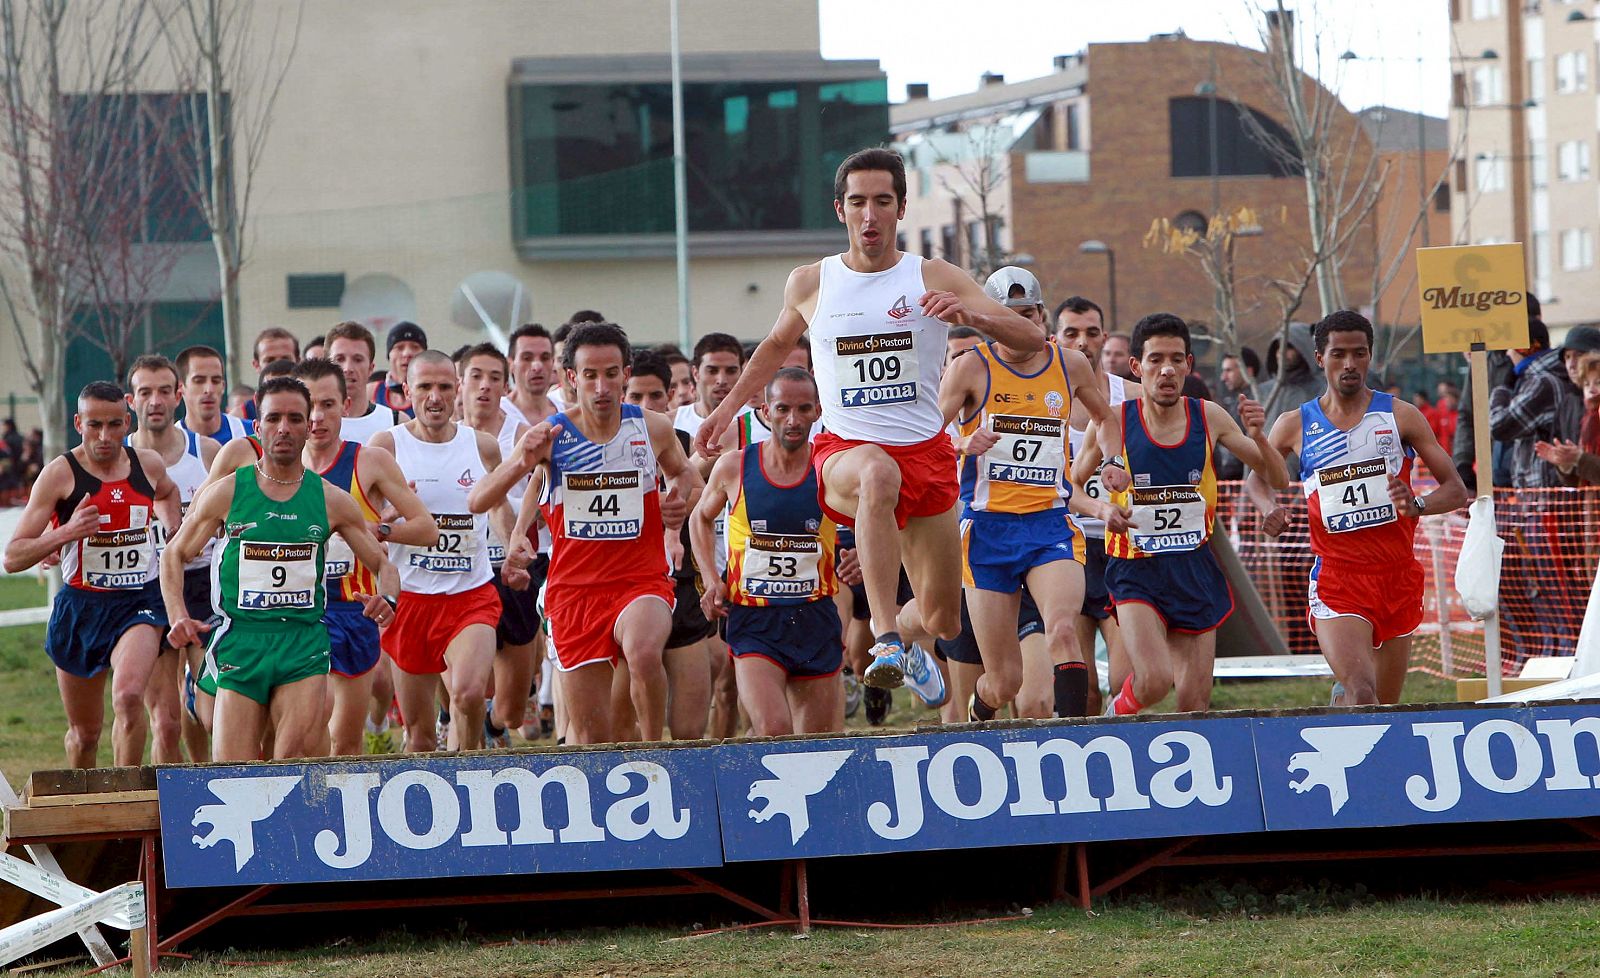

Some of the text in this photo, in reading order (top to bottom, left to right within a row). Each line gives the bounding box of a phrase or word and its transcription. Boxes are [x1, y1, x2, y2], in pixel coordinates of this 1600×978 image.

[1424, 286, 1522, 311] Muga
[838, 342, 864, 350] Divina
[880, 337, 910, 347] Pastora
[854, 356, 900, 382] 109
[861, 384, 914, 404] Joma
[995, 420, 1019, 430] Divina
[1012, 440, 1042, 462] 67
[569, 478, 593, 486] Divina
[608, 476, 636, 484] Pastora
[1007, 467, 1054, 482] Joma
[1320, 472, 1343, 482] Divina
[1356, 464, 1384, 474] Pastora
[1134, 492, 1158, 500] Divina
[1342, 483, 1369, 506] 41
[588, 494, 620, 516] 44
[1154, 508, 1181, 530] 52
[1346, 506, 1391, 528] Joma
[587, 522, 637, 537] Joma
[125, 533, 146, 543] Pastora
[752, 539, 774, 547] Divina
[789, 540, 816, 549] Pastora
[1152, 534, 1200, 549] Joma
[101, 550, 139, 569] 119
[246, 547, 270, 556] Divina
[286, 548, 310, 557] Pastora
[426, 557, 470, 569] Joma
[768, 556, 796, 577] 53
[104, 572, 146, 586] Joma
[272, 566, 286, 587] 9
[764, 581, 812, 594] Joma
[261, 592, 308, 607] Joma
[867, 731, 1232, 840] Joma
[314, 761, 690, 869] Joma
